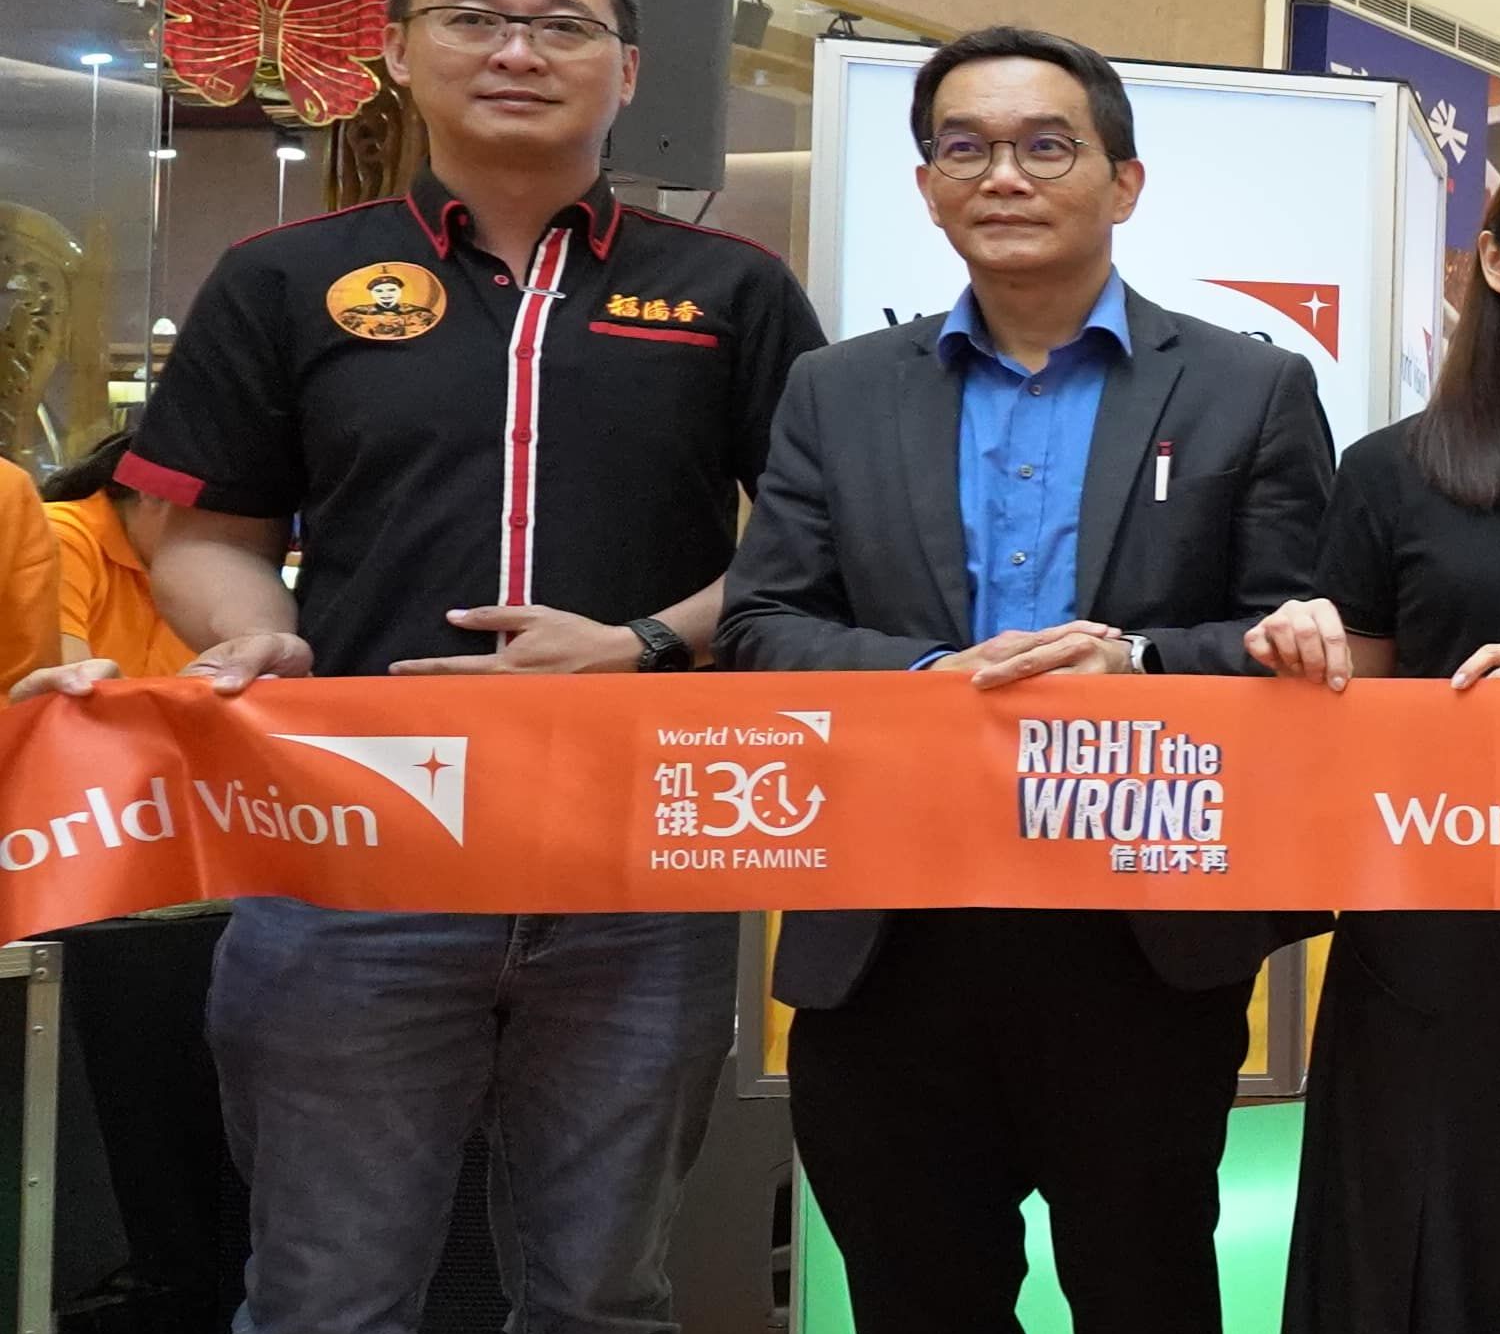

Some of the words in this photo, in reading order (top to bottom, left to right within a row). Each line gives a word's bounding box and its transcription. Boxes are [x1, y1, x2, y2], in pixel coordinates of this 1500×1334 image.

[658, 727, 728, 745] World
[735, 728, 803, 745] Vision
[1019, 719, 1162, 774] RIGHT
[1160, 733, 1221, 776] the
[0, 785, 174, 872] orld
[195, 781, 378, 846] Vision
[1019, 778, 1225, 843] WRONG
[652, 850, 724, 869] HOUR
[733, 849, 826, 868] FAMINE
